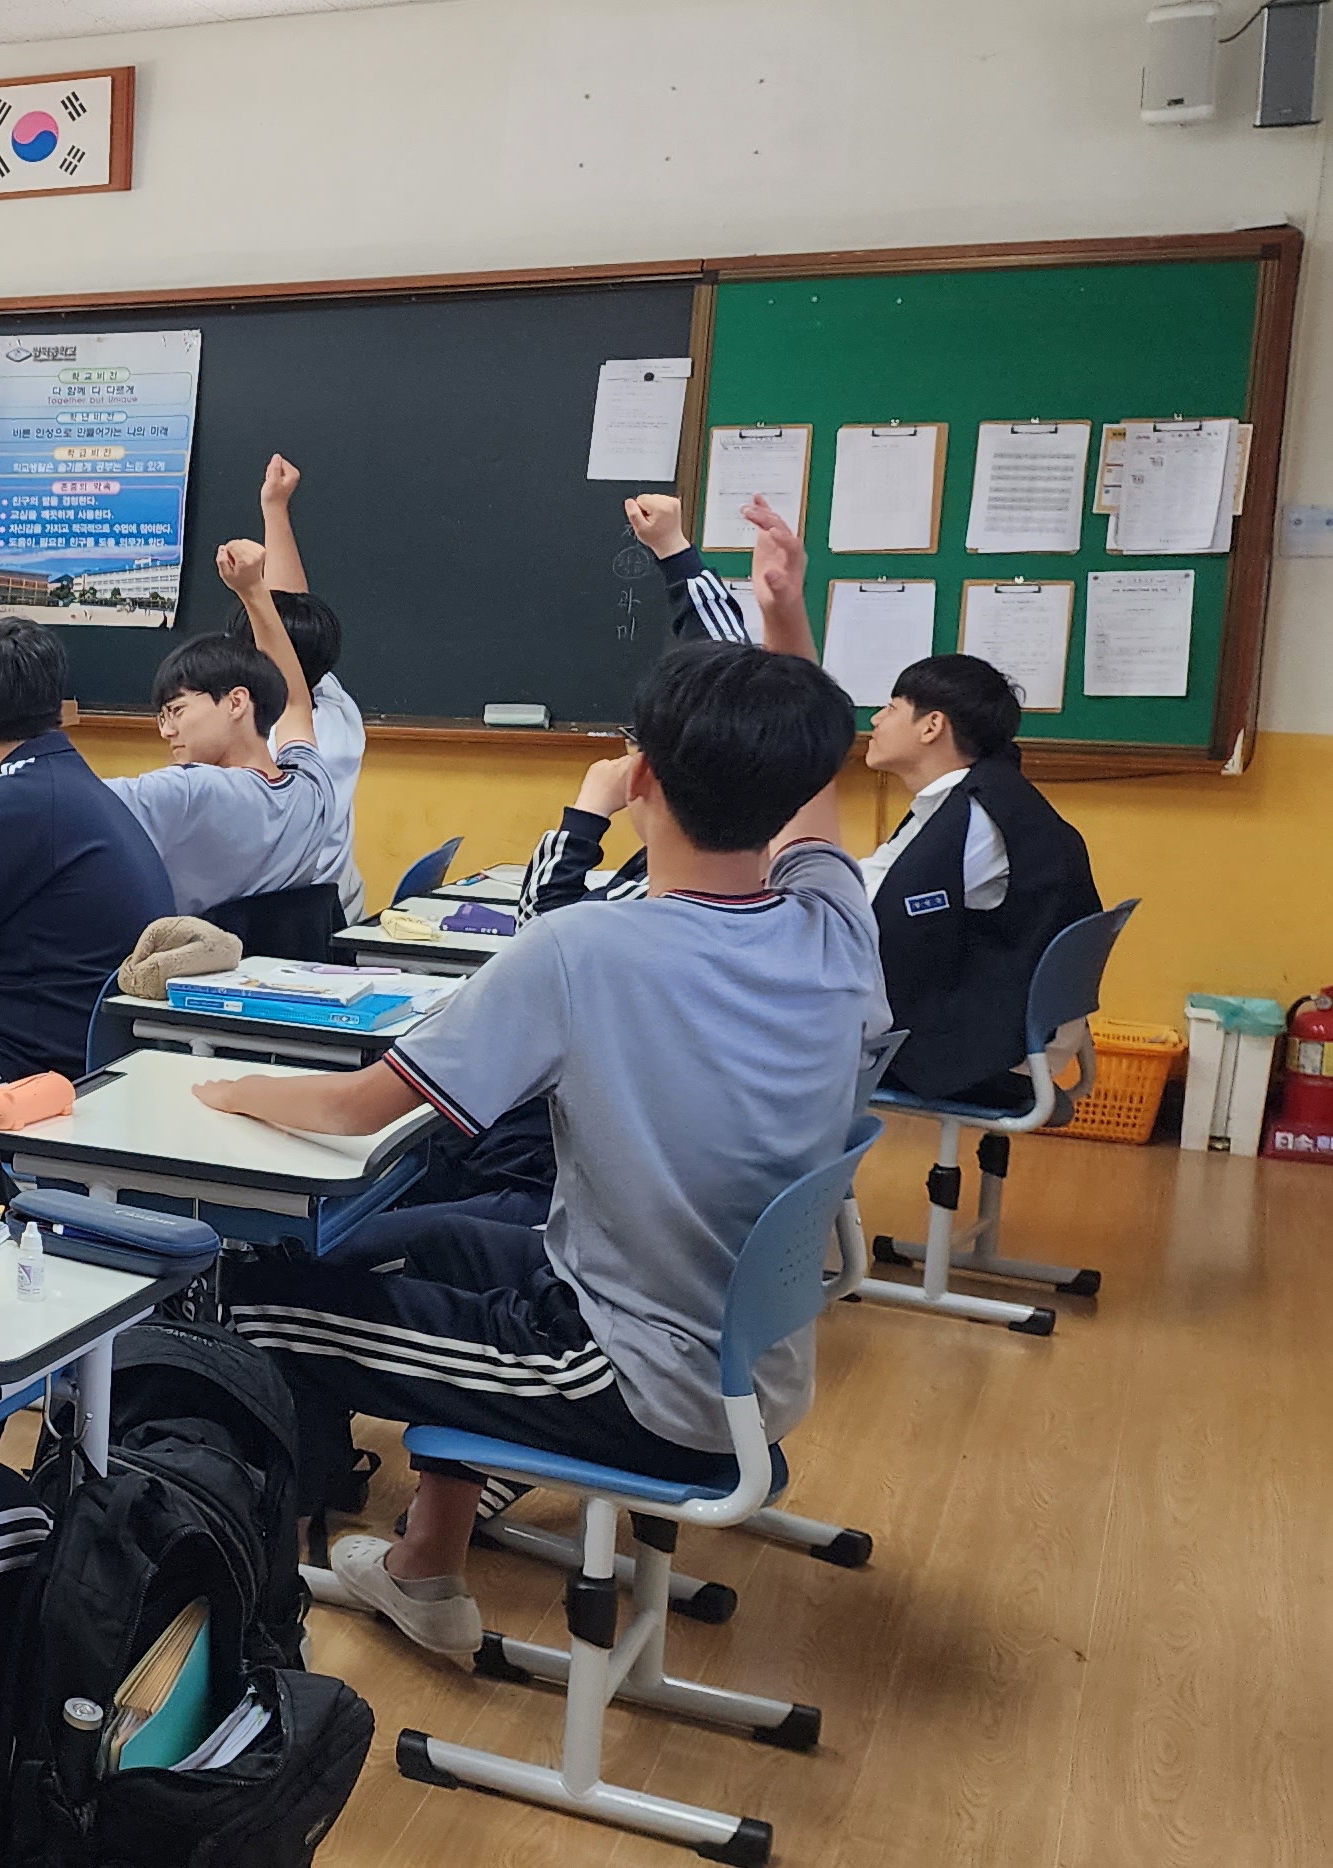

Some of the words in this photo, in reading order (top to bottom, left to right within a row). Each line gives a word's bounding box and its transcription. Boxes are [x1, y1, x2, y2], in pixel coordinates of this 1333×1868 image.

[47, 397, 85, 405] Together
[12, 428, 31, 439] 바른
[35, 428, 72, 438] 인성으로
[77, 427, 122, 438] 만들어가는
[127, 427, 145, 437] 나의
[150, 426, 169, 436] 미래
[13, 496, 38, 506] 친구의
[10, 509, 37, 520] 교실을
[41, 509, 74, 520] 깨끗하게
[78, 509, 114, 520] 사용한다.
[9, 523, 42, 534] 자신감을
[45, 523, 69, 533] 가지고
[72, 523, 110, 533] 적극적으로
[113, 523, 137, 534] 수업에
[9, 537, 36, 547] 도움이
[40, 537, 65, 547] 필요한
[70, 537, 94, 547] 친구를
